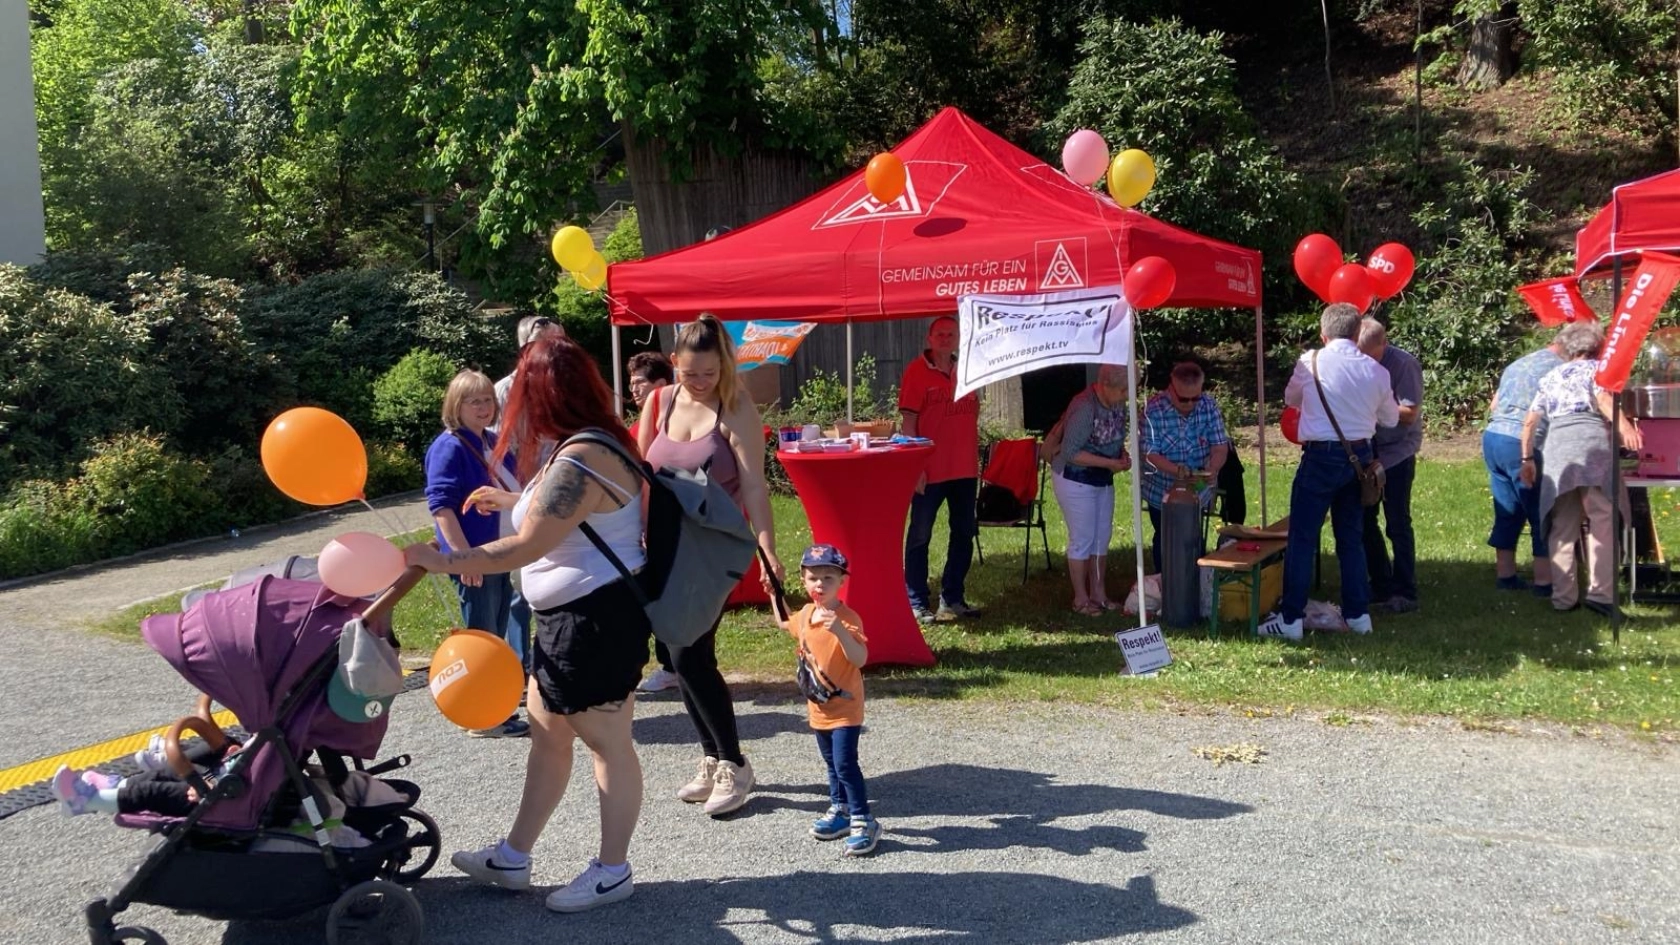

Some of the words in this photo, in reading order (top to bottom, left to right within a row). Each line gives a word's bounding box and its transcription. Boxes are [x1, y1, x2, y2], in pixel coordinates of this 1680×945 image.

[881, 265, 968, 283] GEMEINSAM
[972, 259, 997, 276] FÜR
[1003, 259, 1026, 275] EIN
[1369, 256, 1395, 274] SPD
[936, 282, 980, 297] GUTES
[983, 277, 1027, 293] LEBEN
[1625, 273, 1654, 309] Die
[974, 333, 993, 348] Kein
[996, 325, 1018, 338] Platz
[1021, 321, 1036, 330] für
[1598, 312, 1632, 373] Linke
[988, 340, 1069, 367] www.respekt.tv
[1121, 630, 1161, 650] Respekt!
[438, 662, 464, 685] CDU
